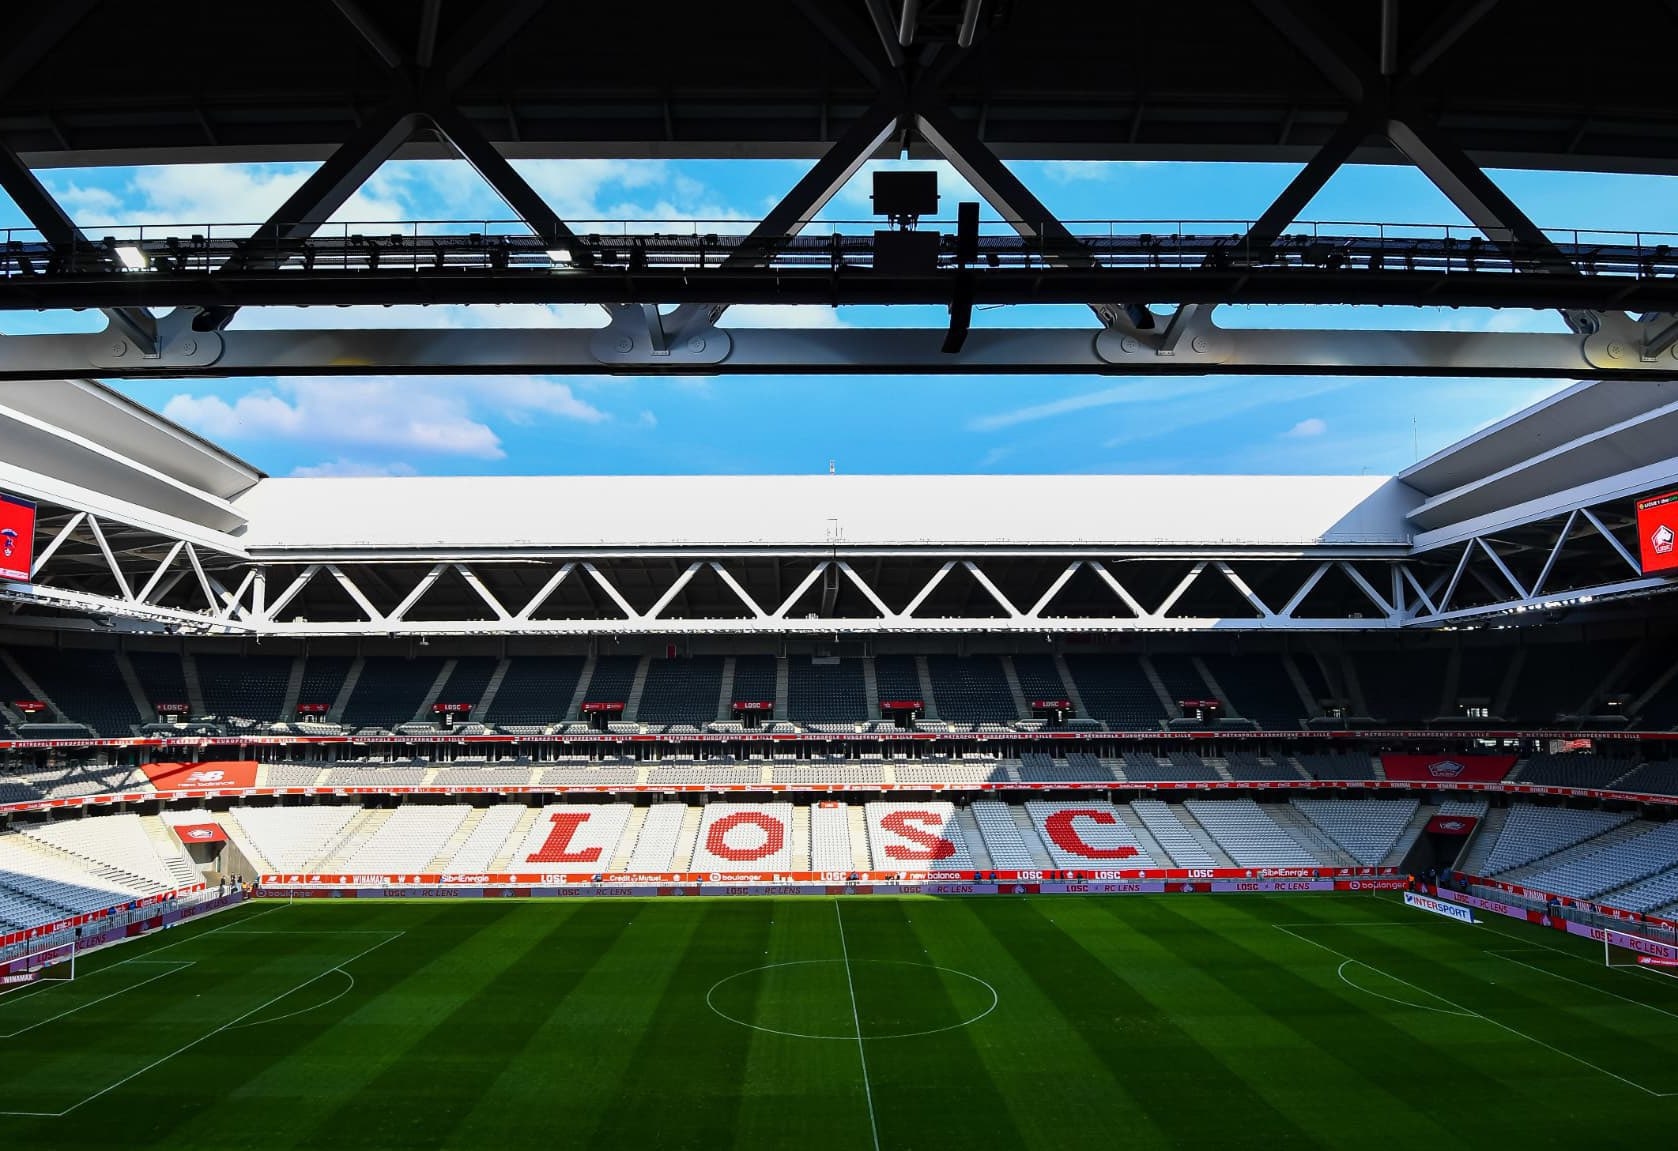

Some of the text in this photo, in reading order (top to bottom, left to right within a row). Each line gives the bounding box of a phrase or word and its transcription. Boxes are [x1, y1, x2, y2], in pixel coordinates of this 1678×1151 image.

[820, 872, 847, 881] LOSC
[927, 871, 960, 880] balance
[1017, 871, 1043, 879] LOSC
[1094, 871, 1121, 879] LOSC
[1188, 869, 1214, 877] LOSC
[352, 875, 384, 884] WINAMAX
[540, 874, 567, 883] LOSC
[722, 874, 762, 882] boulanger
[1361, 882, 1406, 890] boulanger
[1413, 895, 1468, 919] INTERSPORT
[1454, 892, 1508, 914] LOSC RC LENS
[86, 934, 106, 947] LENS
[1590, 929, 1669, 957] LOSC RC LENS
[3, 973, 33, 984] WINAMAX
